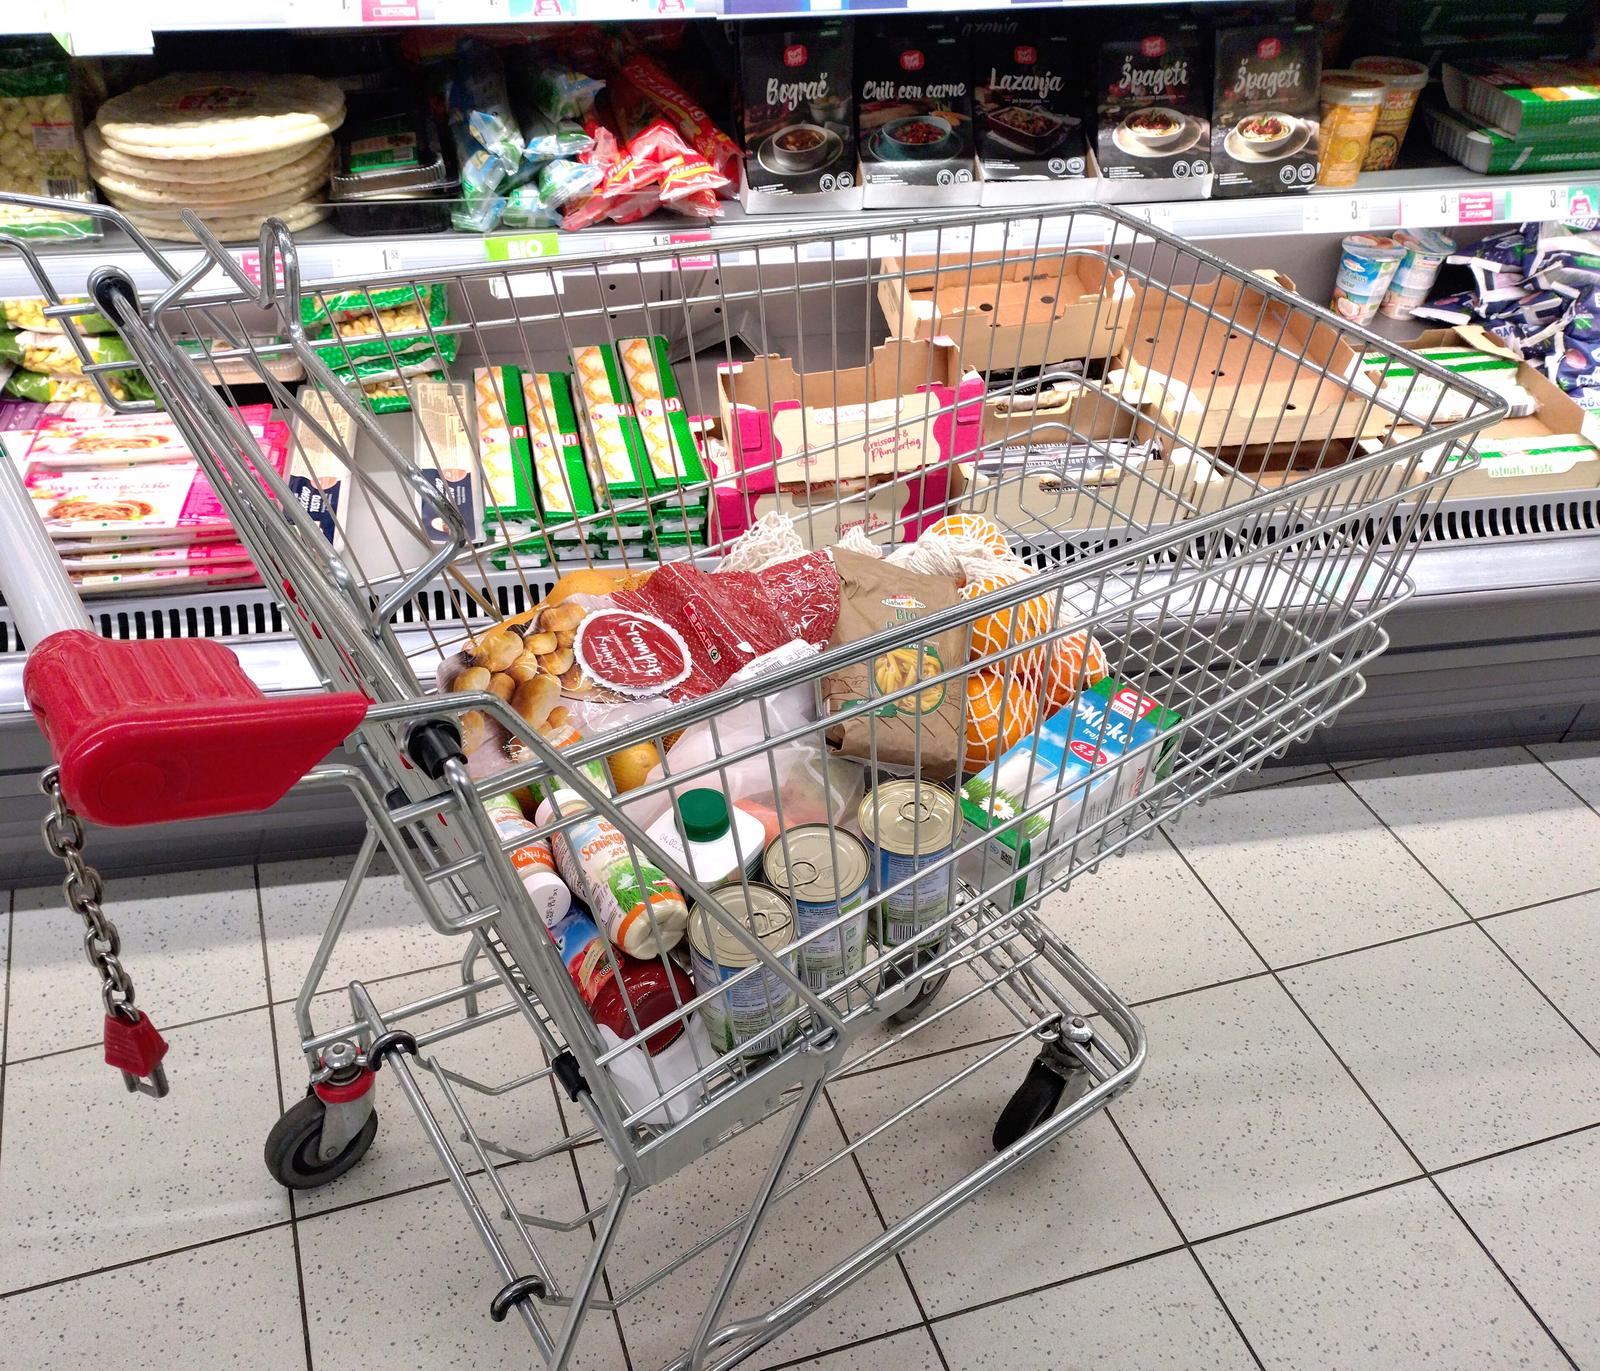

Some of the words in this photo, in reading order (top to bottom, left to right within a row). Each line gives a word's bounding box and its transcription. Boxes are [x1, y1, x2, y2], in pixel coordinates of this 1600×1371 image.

[766, 72, 830, 111] Bograč
[863, 81, 895, 100] Chili
[899, 84, 922, 99] con
[926, 81, 967, 99] carne
[988, 67, 1065, 99] Lazanja
[1119, 55, 1187, 95] Špageti
[1233, 58, 1302, 92] Špageti
[507, 238, 543, 259] BIO
[690, 614, 712, 650] SPAR
[1076, 705, 1134, 745] Mleko
[1083, 728, 1108, 744] trajo
